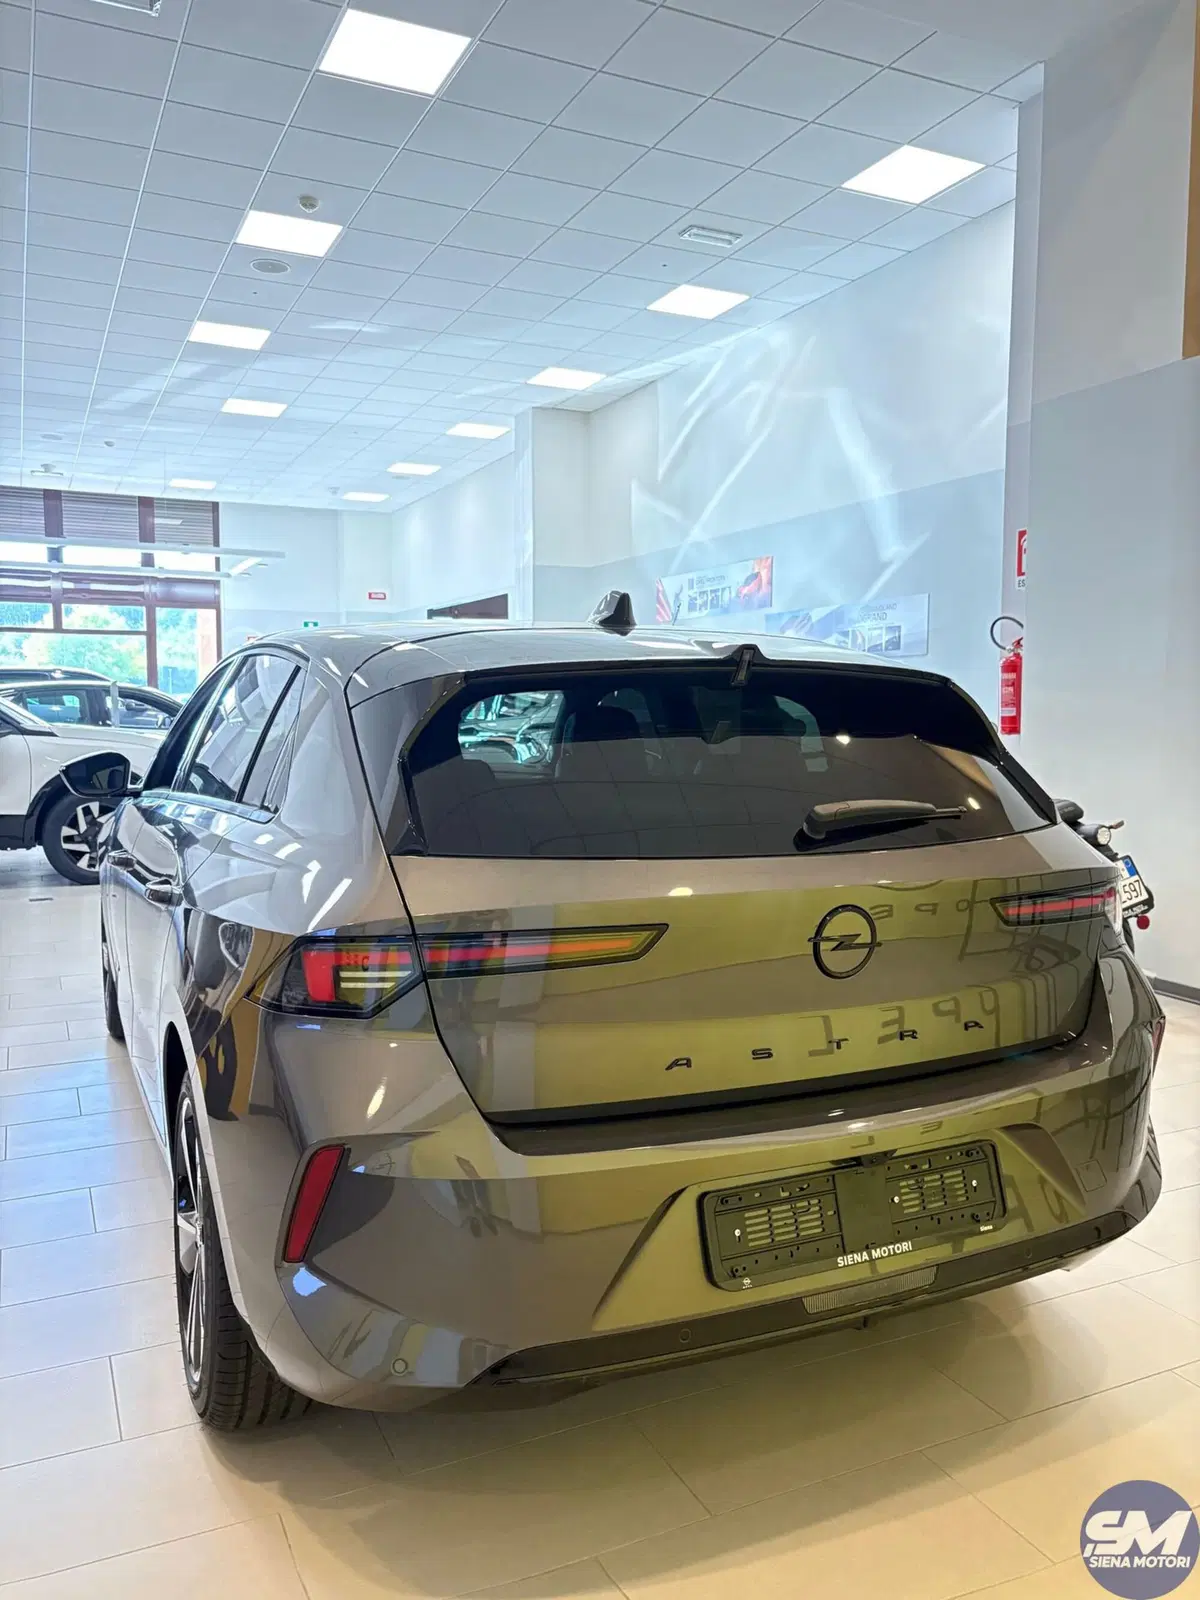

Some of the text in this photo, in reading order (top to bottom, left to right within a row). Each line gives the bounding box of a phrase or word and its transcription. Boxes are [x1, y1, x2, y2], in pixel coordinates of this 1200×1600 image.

[665, 1020, 985, 1071] ASTRA
[837, 1241, 913, 1267] SIENA MOTORI
